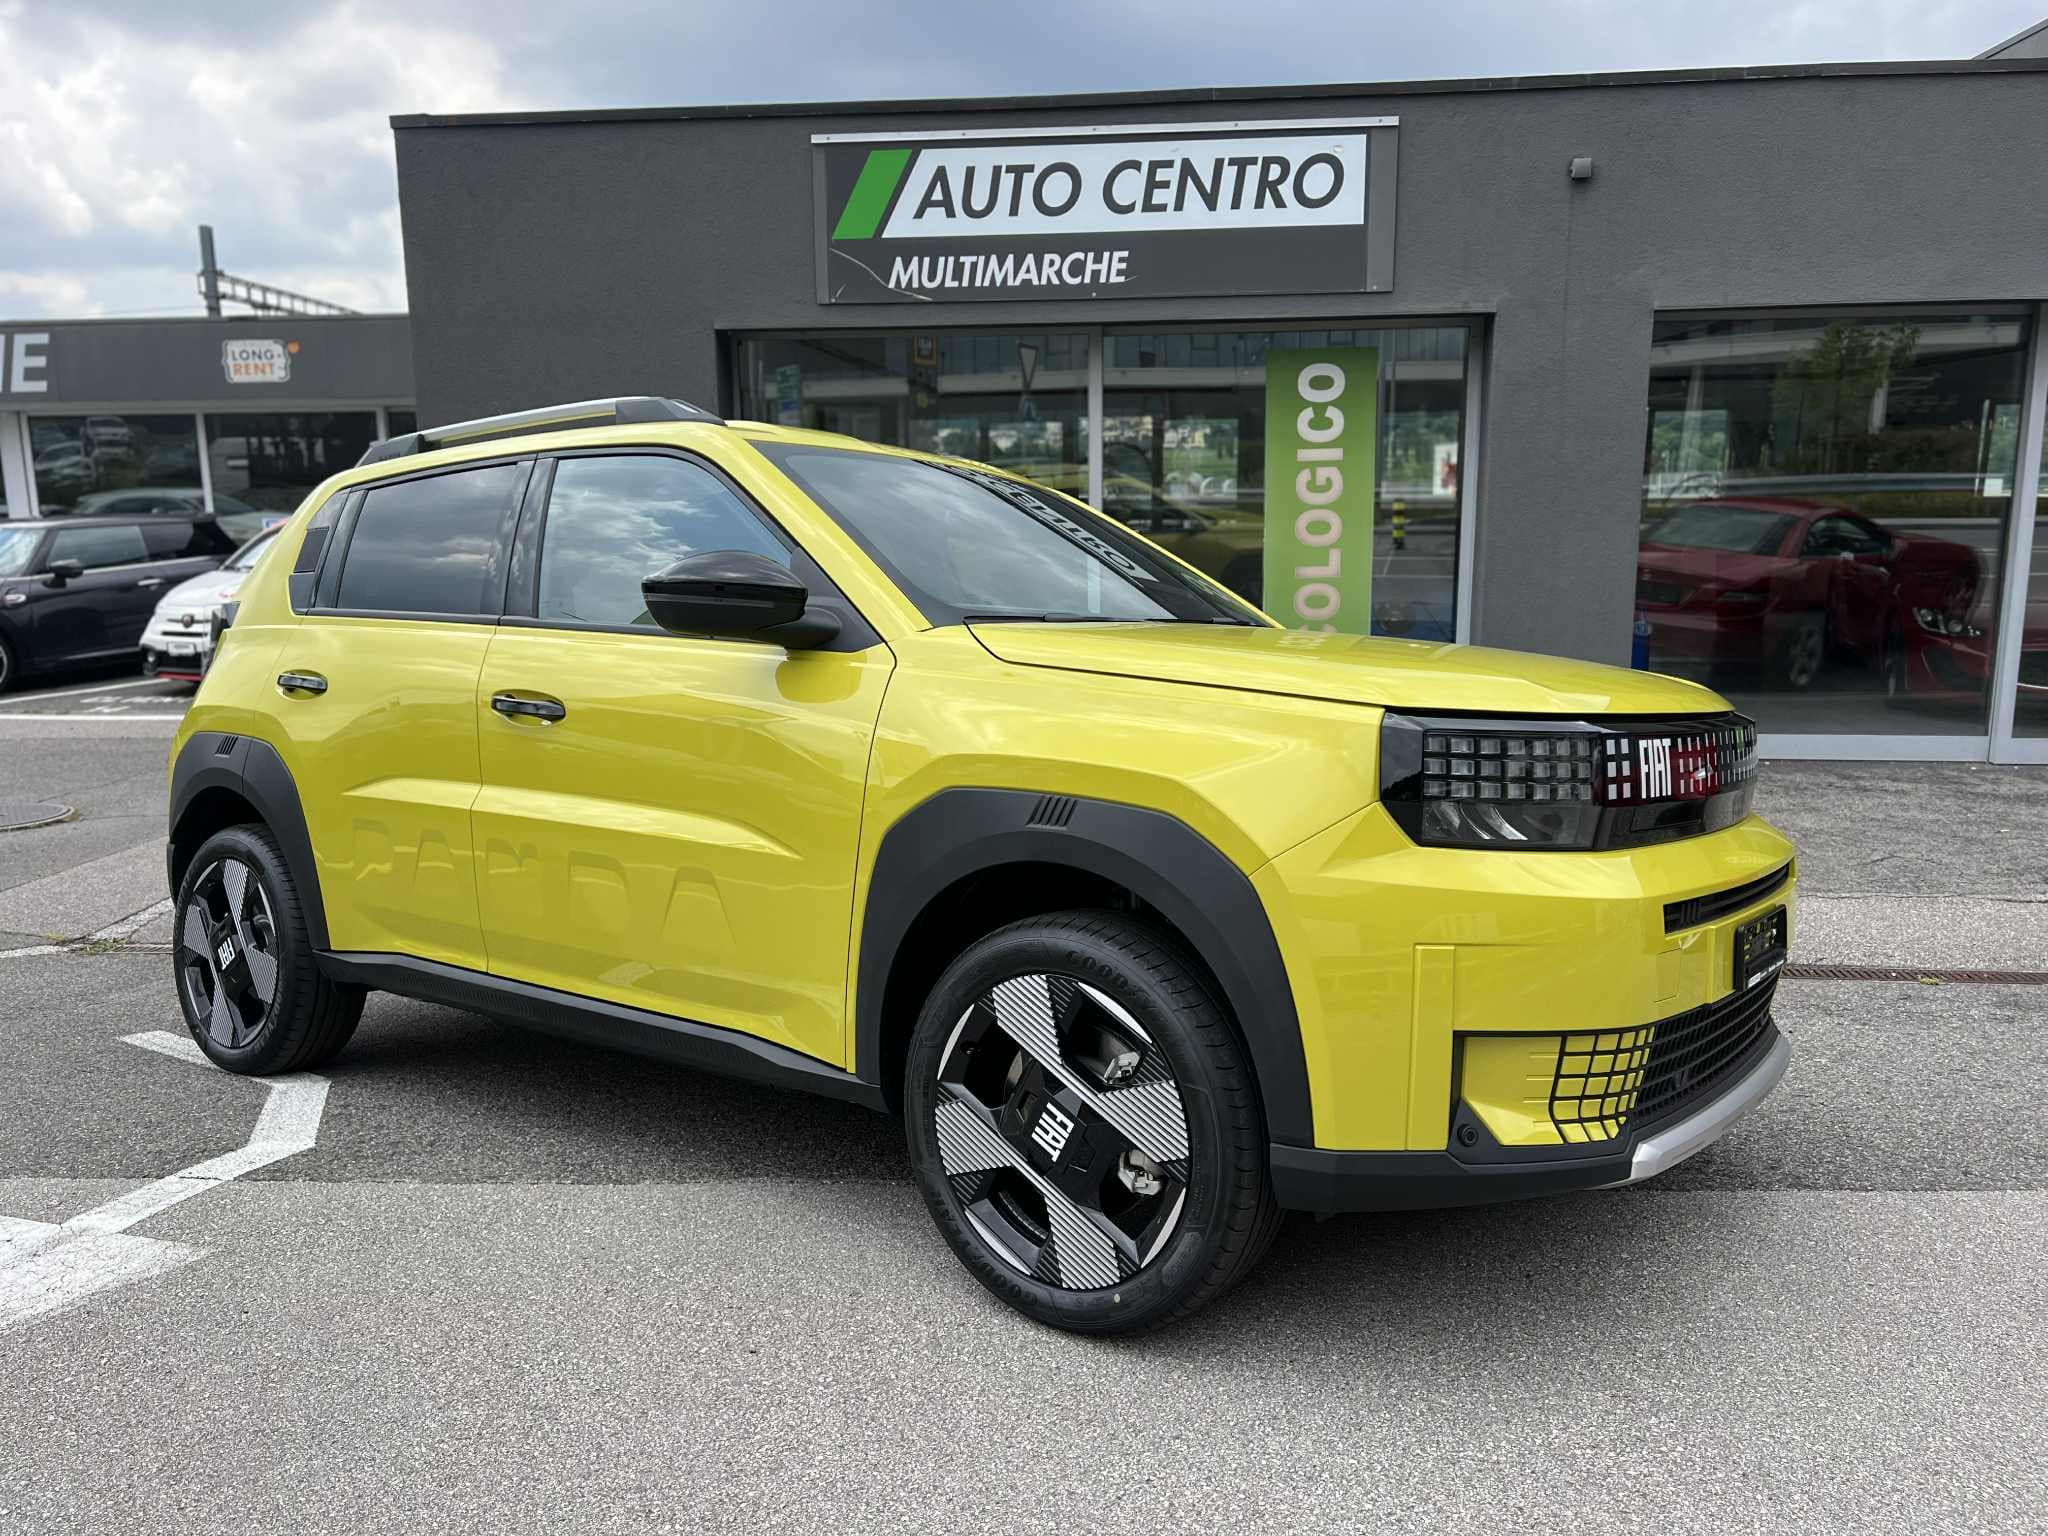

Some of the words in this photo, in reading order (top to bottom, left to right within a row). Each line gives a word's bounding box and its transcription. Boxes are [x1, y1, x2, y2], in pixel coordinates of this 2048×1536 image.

[912, 162, 1082, 220] AUTO
[1101, 153, 1345, 215] CENTRO
[888, 251, 1129, 289] MULTIMARCHE
[0, 333, 49, 392] E
[231, 348, 275, 361] LONG
[232, 363, 274, 376] RENT
[1294, 362, 1346, 633] OLOGICO
[1639, 738, 1672, 799] FIAT
[218, 937, 236, 970] FIAT
[1031, 1102, 1074, 1162] FIAT
